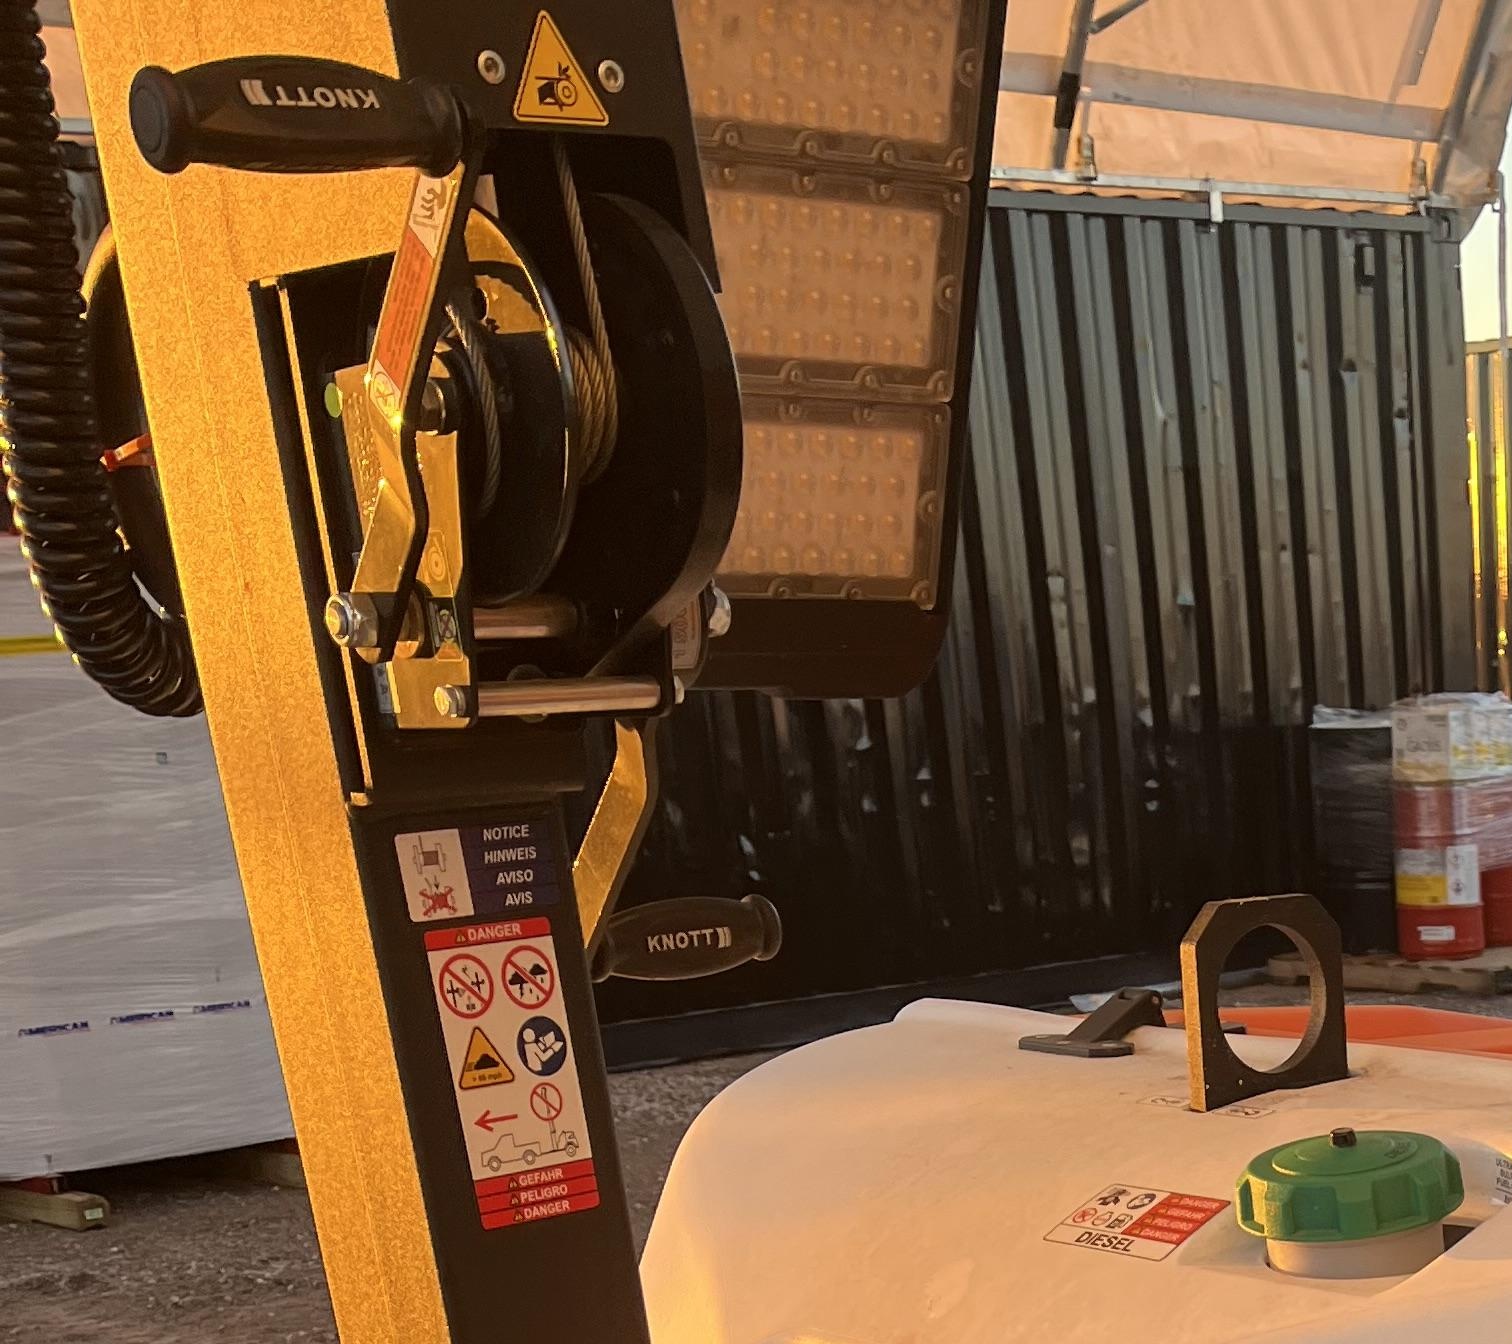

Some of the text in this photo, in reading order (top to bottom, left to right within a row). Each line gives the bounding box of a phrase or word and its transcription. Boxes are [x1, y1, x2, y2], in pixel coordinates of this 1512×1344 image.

[275, 85, 381, 109] KNOTT
[483, 824, 530, 841] NOTICE
[484, 846, 537, 865] HINWEIS
[496, 869, 534, 886] AVISO
[505, 891, 533, 907] AVIS
[467, 923, 522, 941] DANGER
[647, 928, 714, 953] KNOTT
[519, 1168, 564, 1187] GEFAHR
[520, 1184, 568, 1204] PELIGRO
[524, 1200, 570, 1219] DANGER
[1074, 1231, 1135, 1252] DIESEL
